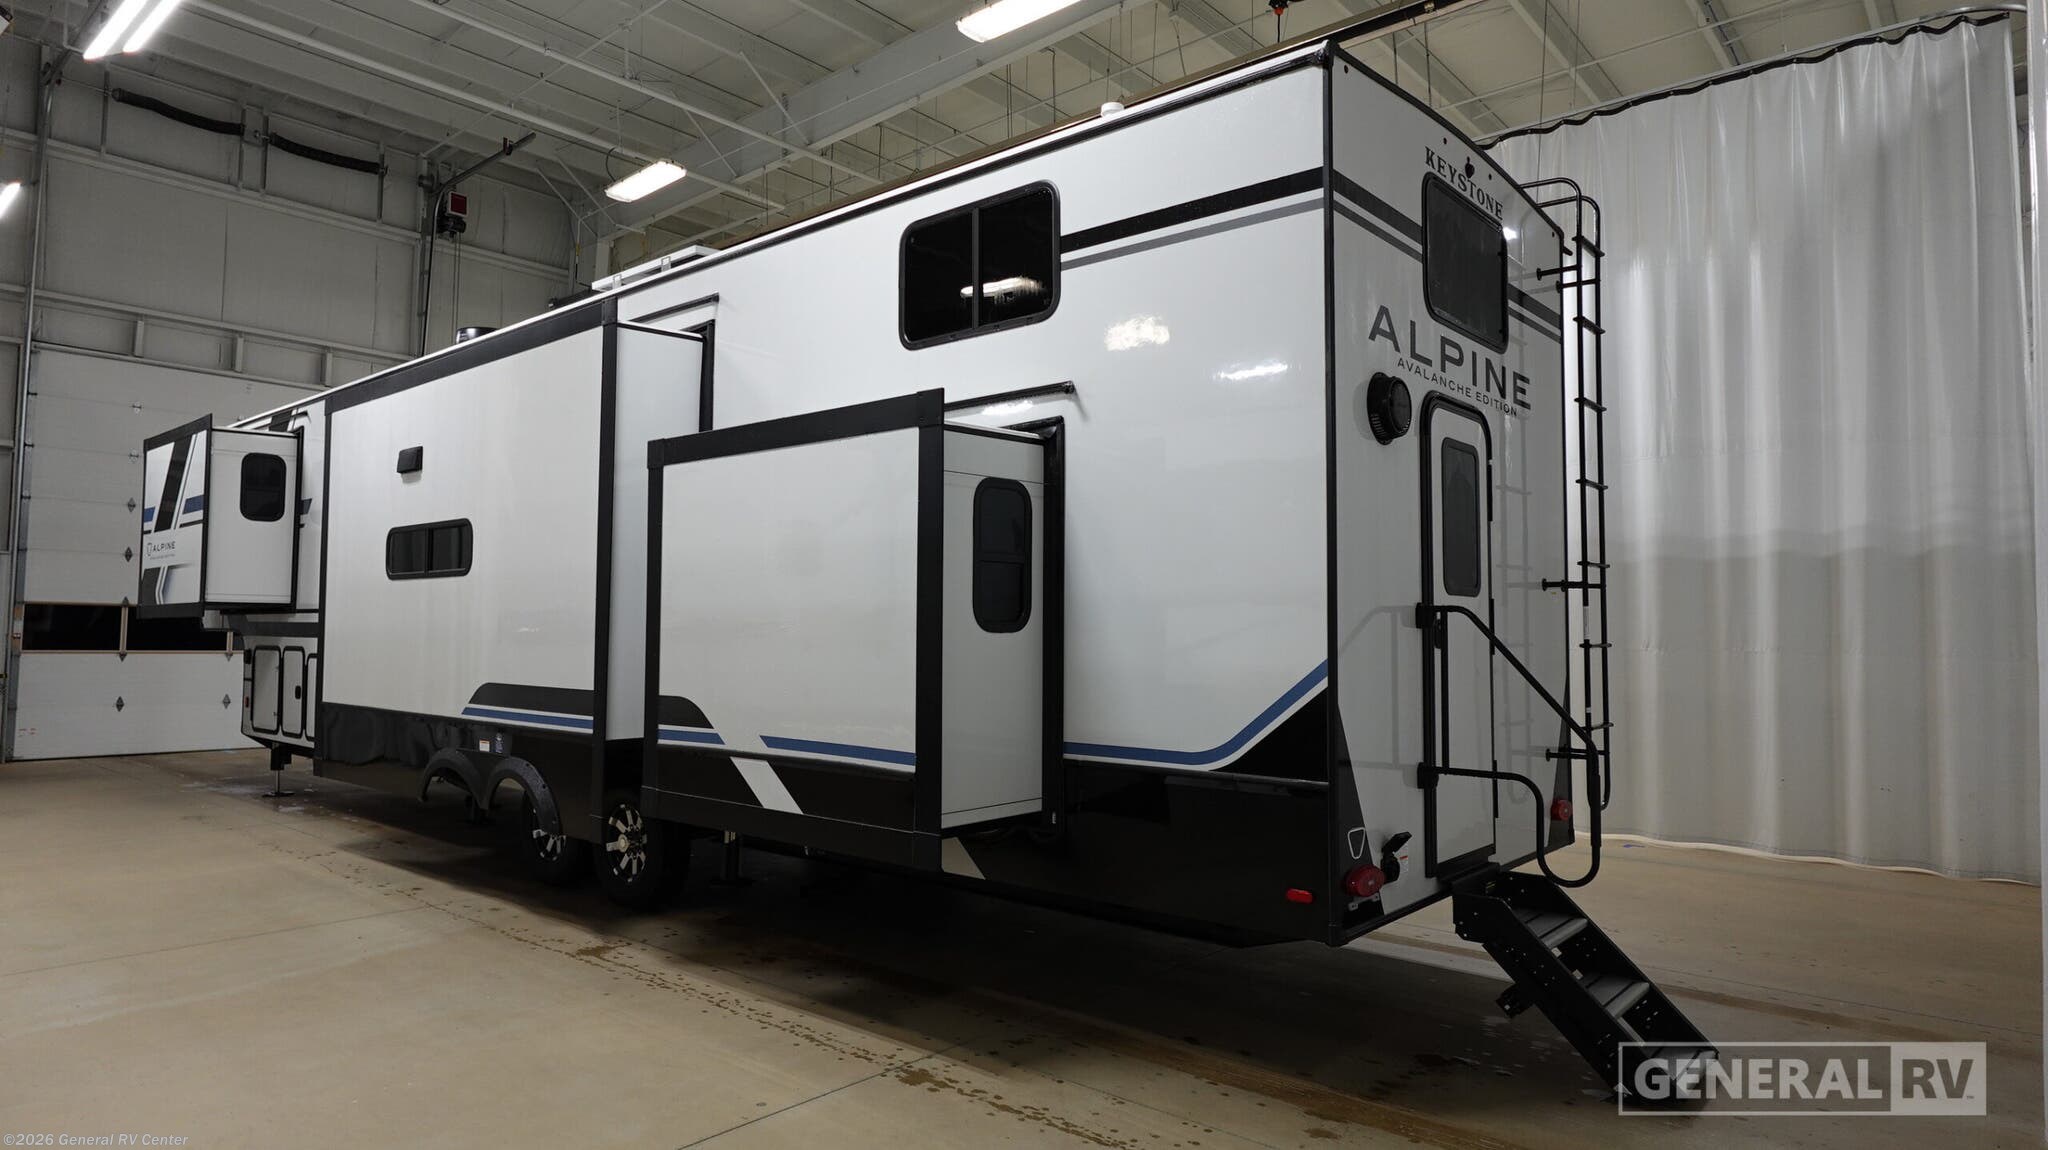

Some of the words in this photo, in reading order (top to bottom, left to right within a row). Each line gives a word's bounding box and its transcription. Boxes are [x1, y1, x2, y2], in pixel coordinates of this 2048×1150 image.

[1424, 146, 1504, 221] KEYSTONE
[1368, 304, 1531, 410] ALPINE
[1397, 357, 1471, 398] AVALANCHE
[1475, 391, 1518, 417] EDITION
[152, 540, 176, 551] ALPINE
